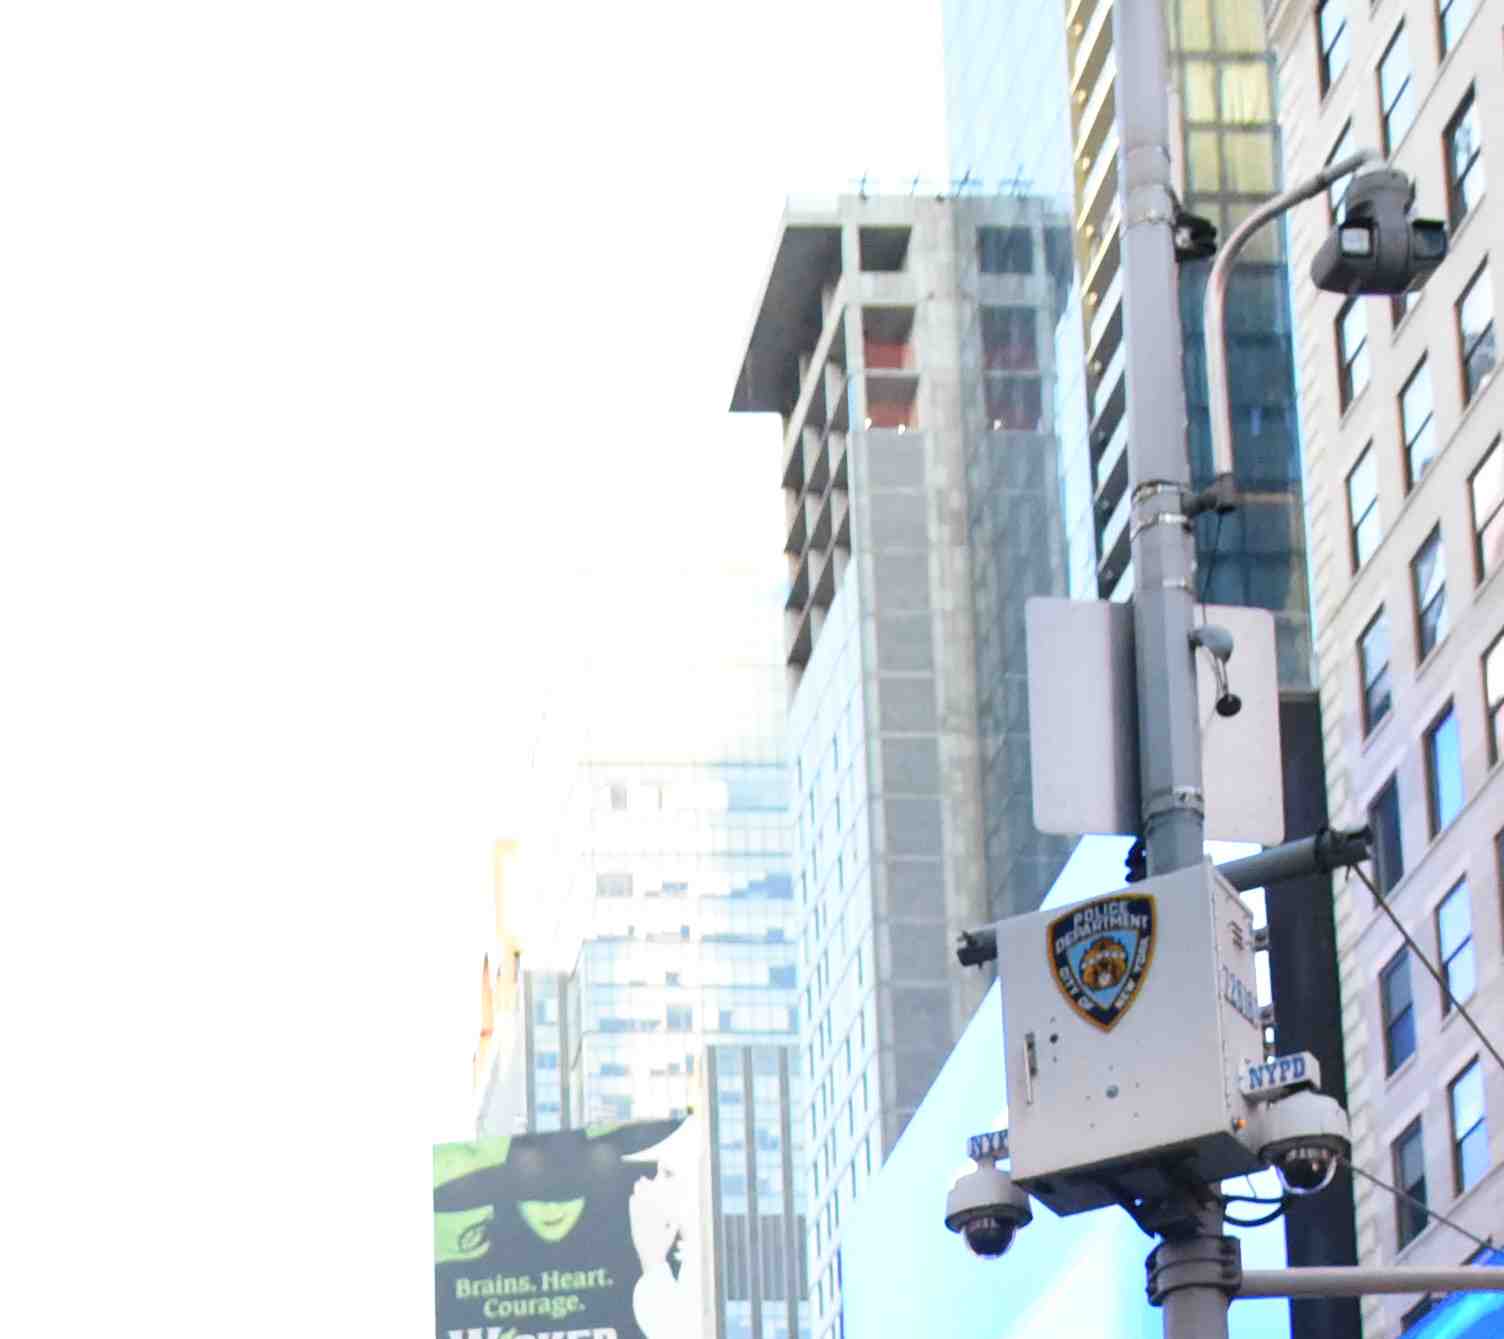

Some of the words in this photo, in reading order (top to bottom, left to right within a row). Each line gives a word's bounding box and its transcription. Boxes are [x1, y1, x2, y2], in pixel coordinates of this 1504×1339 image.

[1073, 900, 1129, 927] POLICE
[1055, 913, 1149, 954] DEPARTMENT
[1247, 1056, 1306, 1090] NYPD
[455, 1272, 538, 1299] Brains.
[541, 1267, 613, 1293] Heart.
[482, 1292, 586, 1320] Courage.
